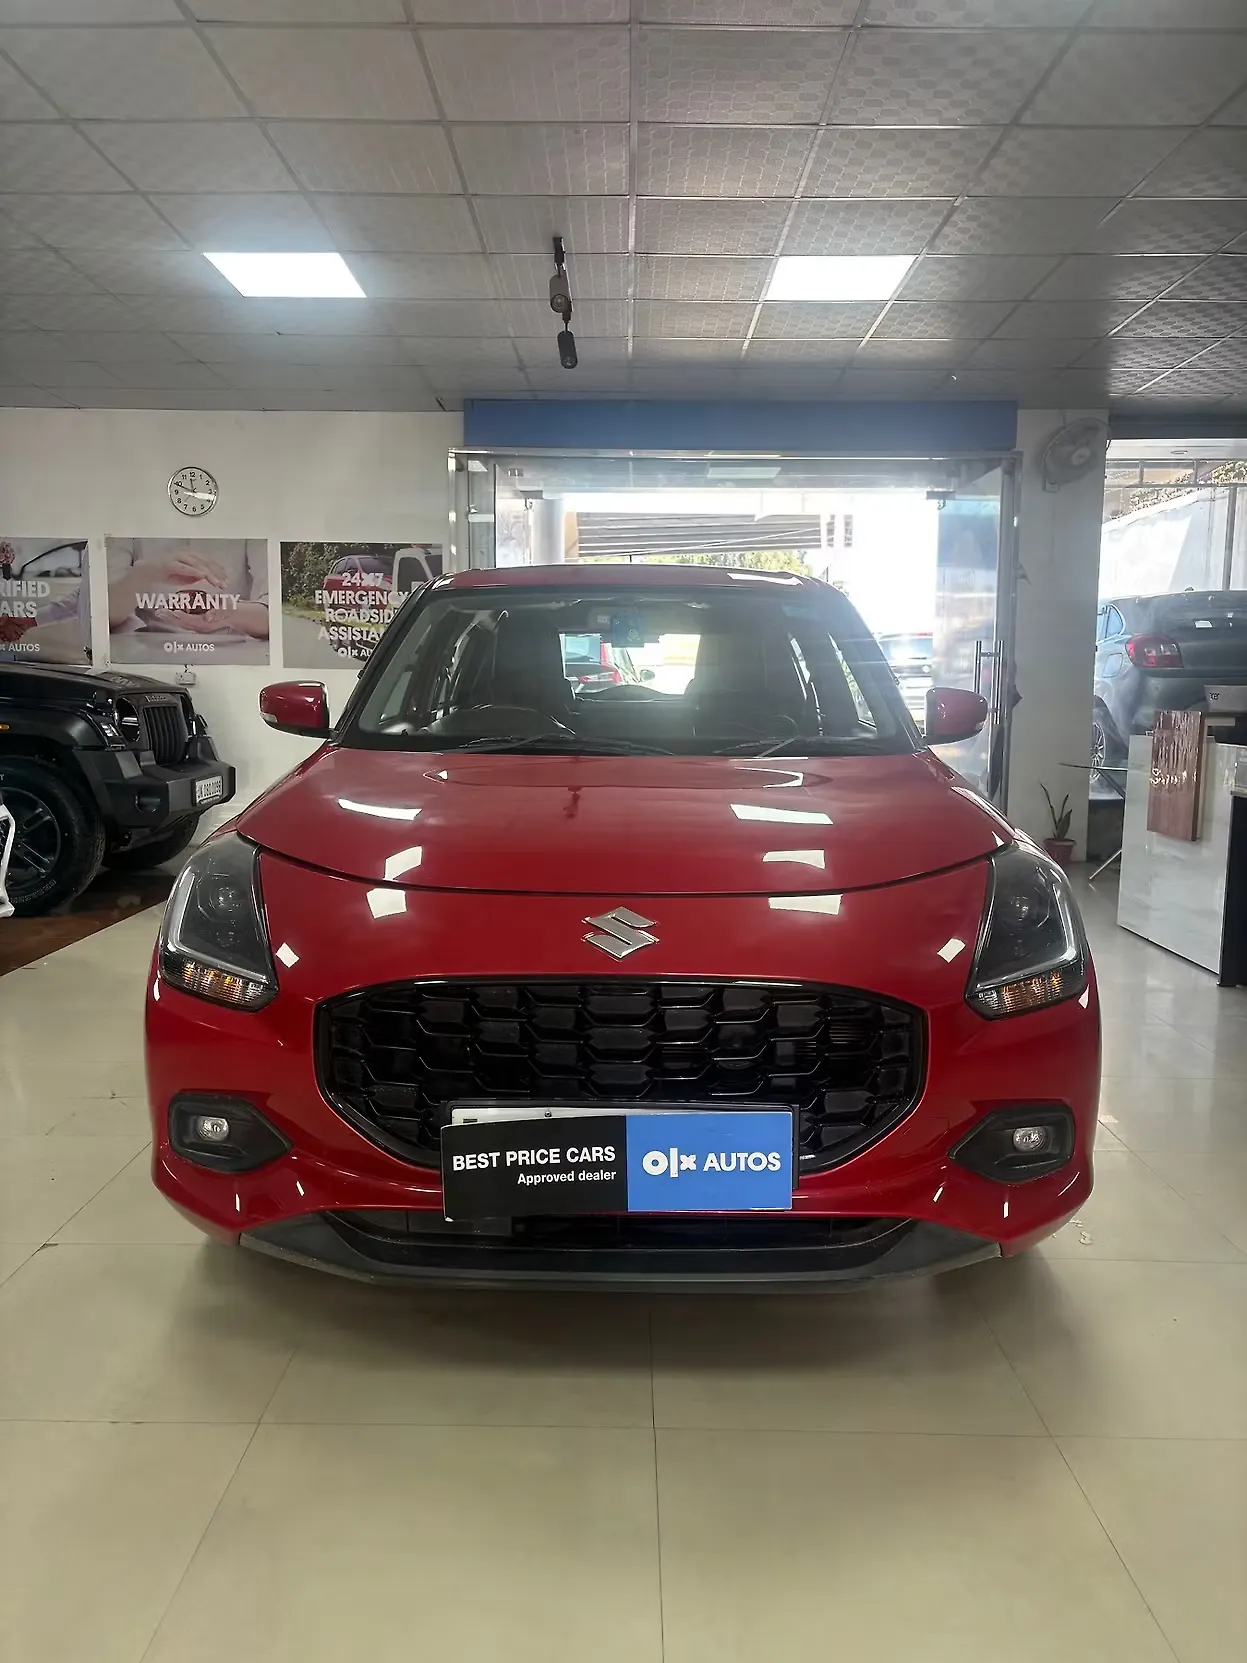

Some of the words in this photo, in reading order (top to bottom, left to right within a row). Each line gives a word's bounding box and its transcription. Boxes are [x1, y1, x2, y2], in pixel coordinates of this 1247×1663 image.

[135, 591, 241, 610] WARRANTY
[325, 608, 399, 623] ROADSID
[8, 643, 41, 652] AUTOS
[185, 643, 215, 652] AUTOS
[452, 1151, 501, 1172] BEST
[506, 1148, 561, 1167] PRICE
[566, 1145, 617, 1164] CARS
[702, 1152, 782, 1172] AUTOS
[517, 1170, 575, 1186] Approved
[578, 1169, 618, 1182] dealer
